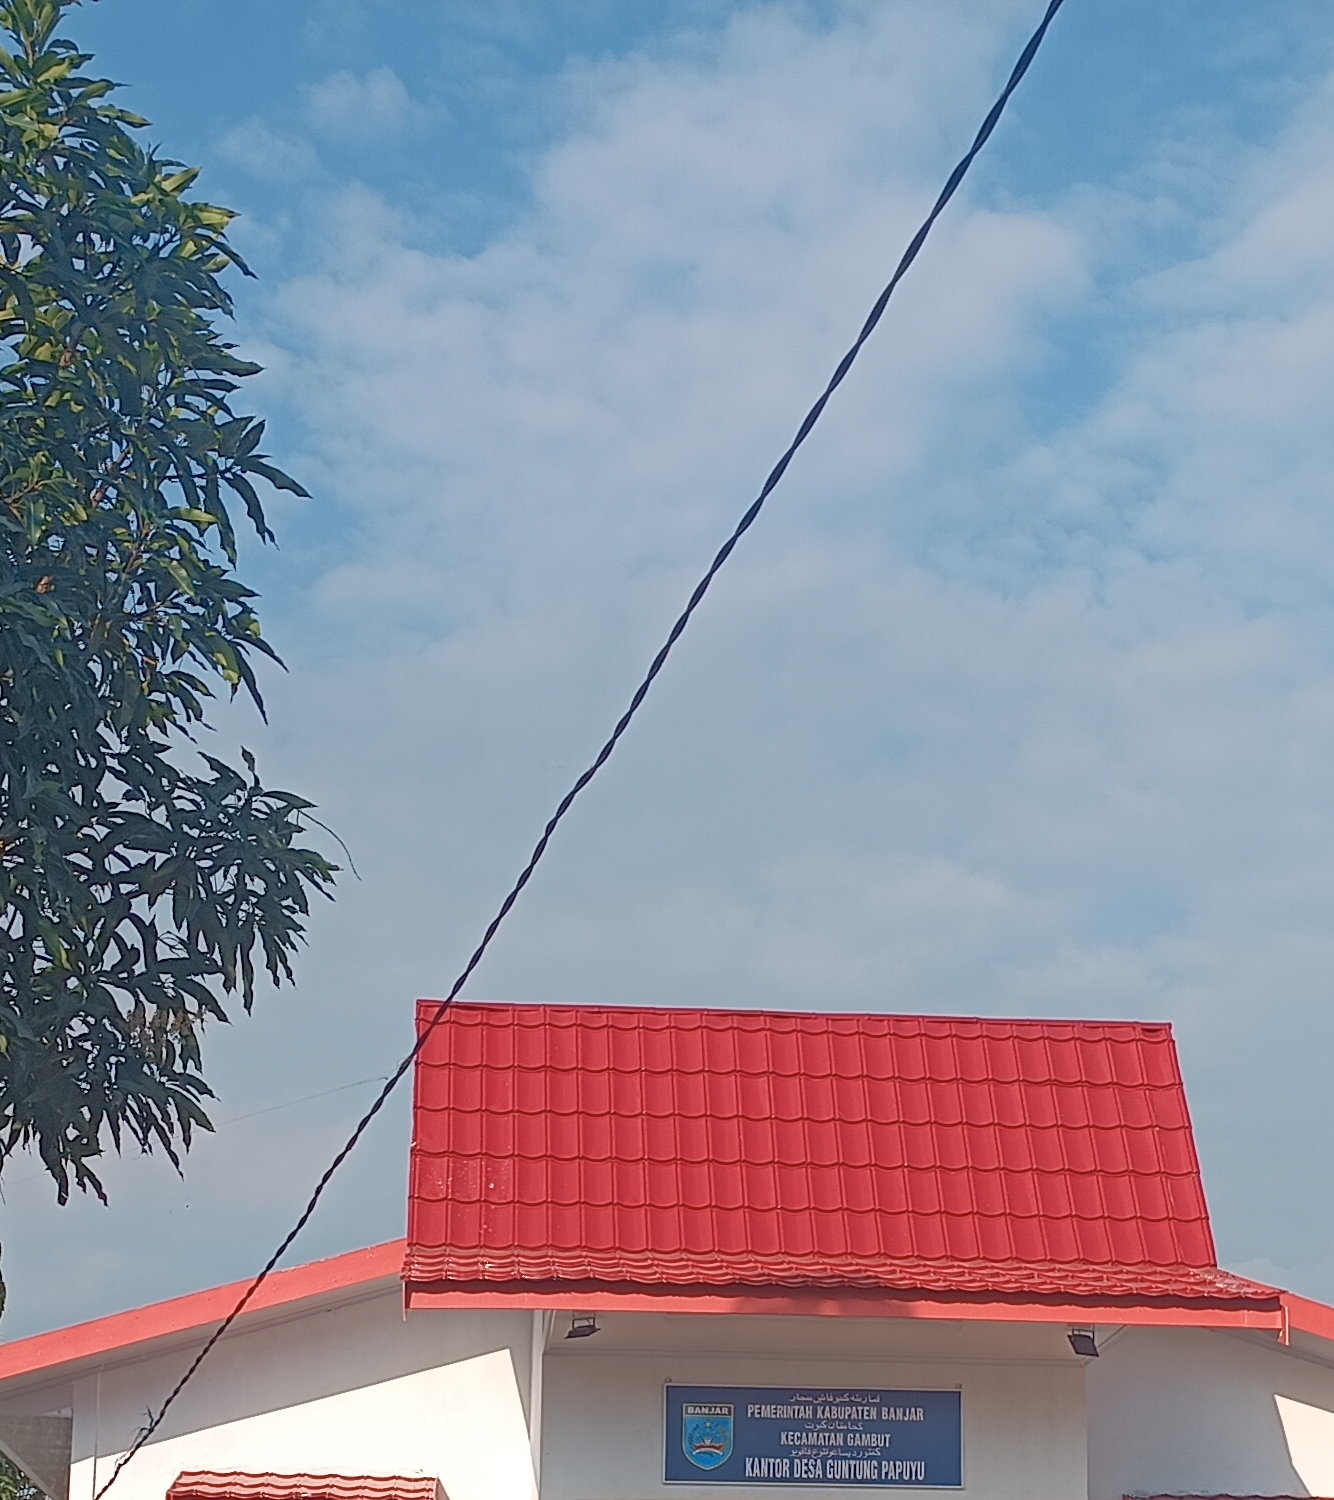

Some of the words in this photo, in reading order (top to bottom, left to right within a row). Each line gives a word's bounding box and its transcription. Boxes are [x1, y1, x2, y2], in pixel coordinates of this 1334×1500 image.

[687, 1406, 729, 1415] BANJAR
[747, 1404, 813, 1419] PEMERINTAH
[817, 1406, 877, 1420] KABUPATEN
[881, 1407, 924, 1421] BANJAR
[780, 1431, 844, 1446] KECAMATAN
[847, 1433, 891, 1447] GAMBUT
[745, 1457, 790, 1478] KANTOR
[793, 1459, 822, 1479] DESA
[826, 1459, 878, 1480] GUNTUNG
[881, 1461, 925, 1481] PAPUYU
